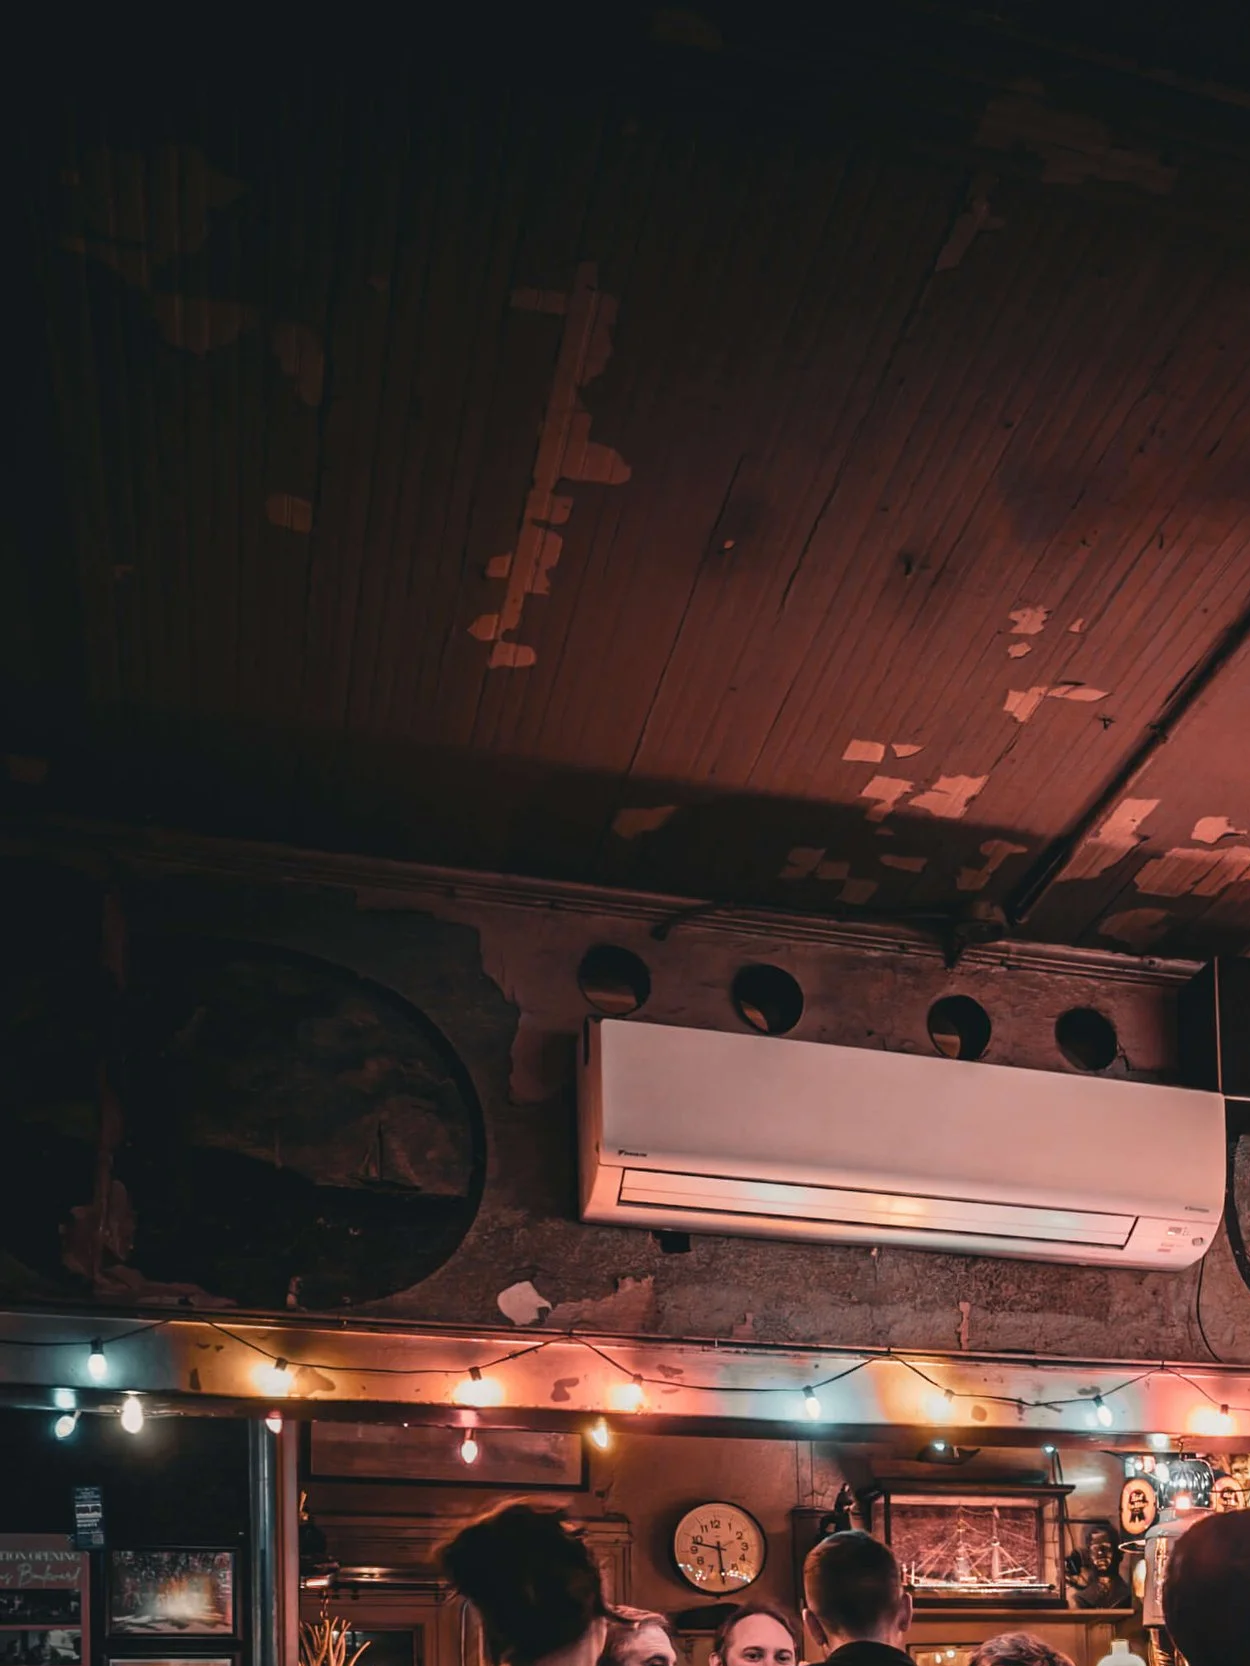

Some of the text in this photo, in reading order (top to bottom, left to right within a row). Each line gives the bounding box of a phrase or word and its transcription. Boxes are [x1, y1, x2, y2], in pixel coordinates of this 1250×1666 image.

[700, 1524, 709, 1533] 11
[710, 1520, 721, 1529] 12
[728, 1522, 732, 1531] 1
[692, 1535, 704, 1544] 10
[735, 1531, 743, 1540] 2
[690, 1546, 698, 1554] 9
[741, 1542, 749, 1551] 3
[696, 1556, 704, 1565] 8
[739, 1553, 746, 1562] 4
[708, 1565, 714, 1573] 7
